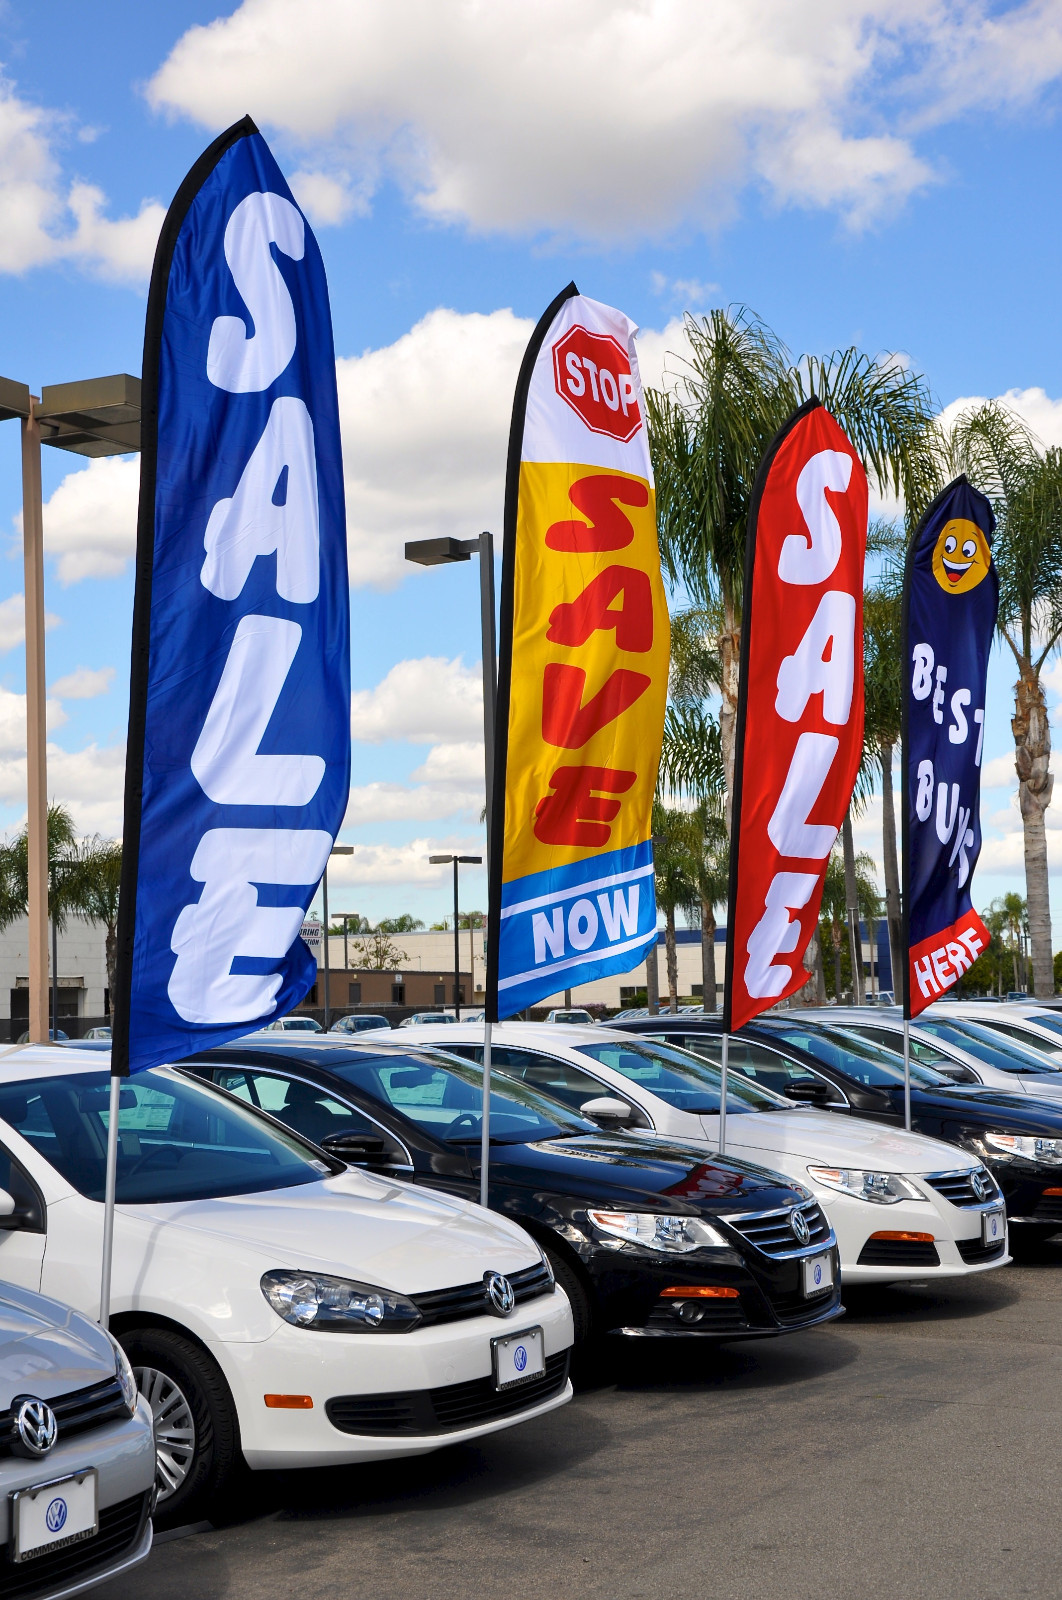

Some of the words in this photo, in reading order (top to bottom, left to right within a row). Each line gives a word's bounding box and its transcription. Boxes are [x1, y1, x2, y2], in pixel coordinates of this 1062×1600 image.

[565, 352, 638, 417] STOP
[167, 191, 334, 1024] SALE
[533, 474, 654, 848] SAVE
[743, 449, 856, 999] SALE
[915, 759, 975, 889] BUYS
[531, 884, 641, 965] NOW
[20, 1527, 95, 1561] COMMONWEALTH
